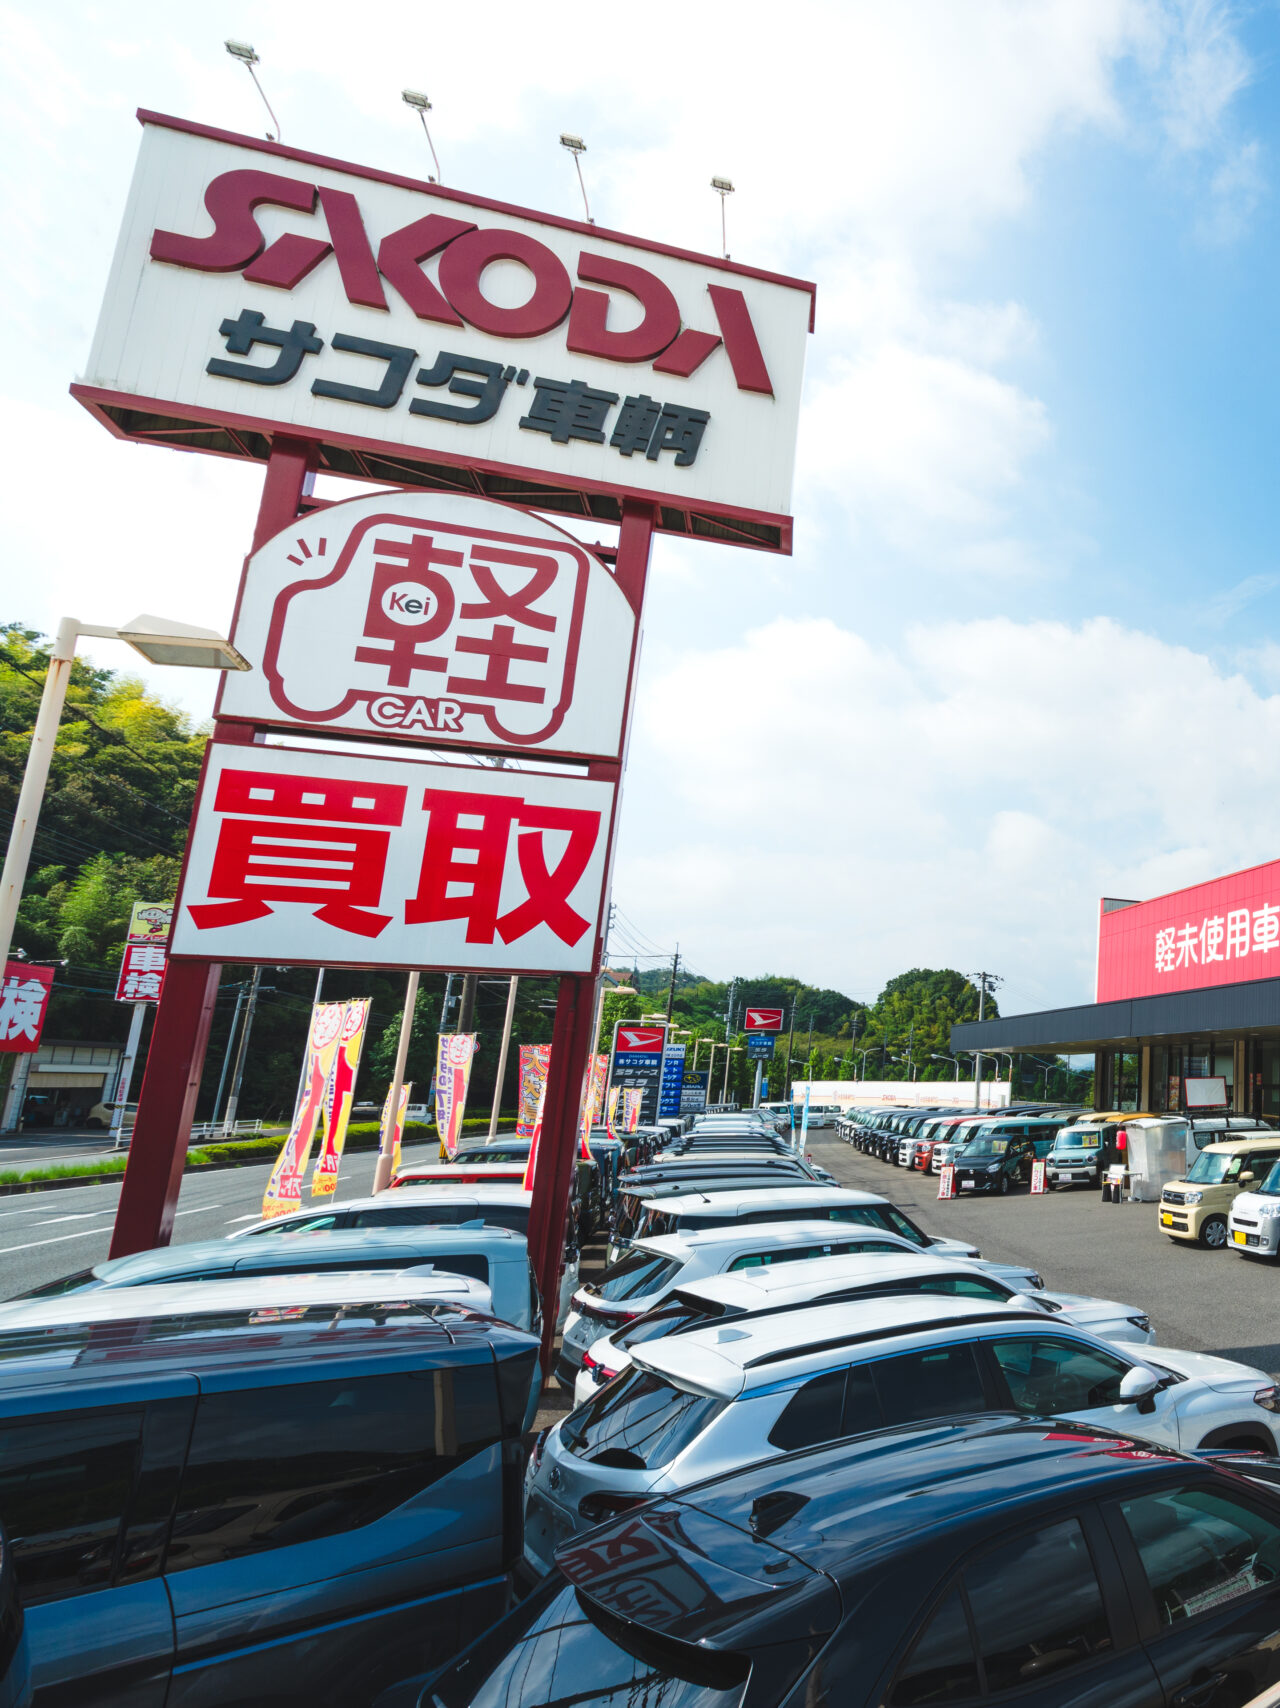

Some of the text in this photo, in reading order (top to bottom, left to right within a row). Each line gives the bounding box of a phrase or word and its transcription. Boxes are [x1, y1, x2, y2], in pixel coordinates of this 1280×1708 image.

[150, 168, 775, 398] SAKODA
[354, 534, 561, 704] 軽
[388, 592, 432, 616] Kei
[368, 696, 463, 732] CAR
[187, 768, 602, 948] 買取
[123, 946, 166, 998] 車検
